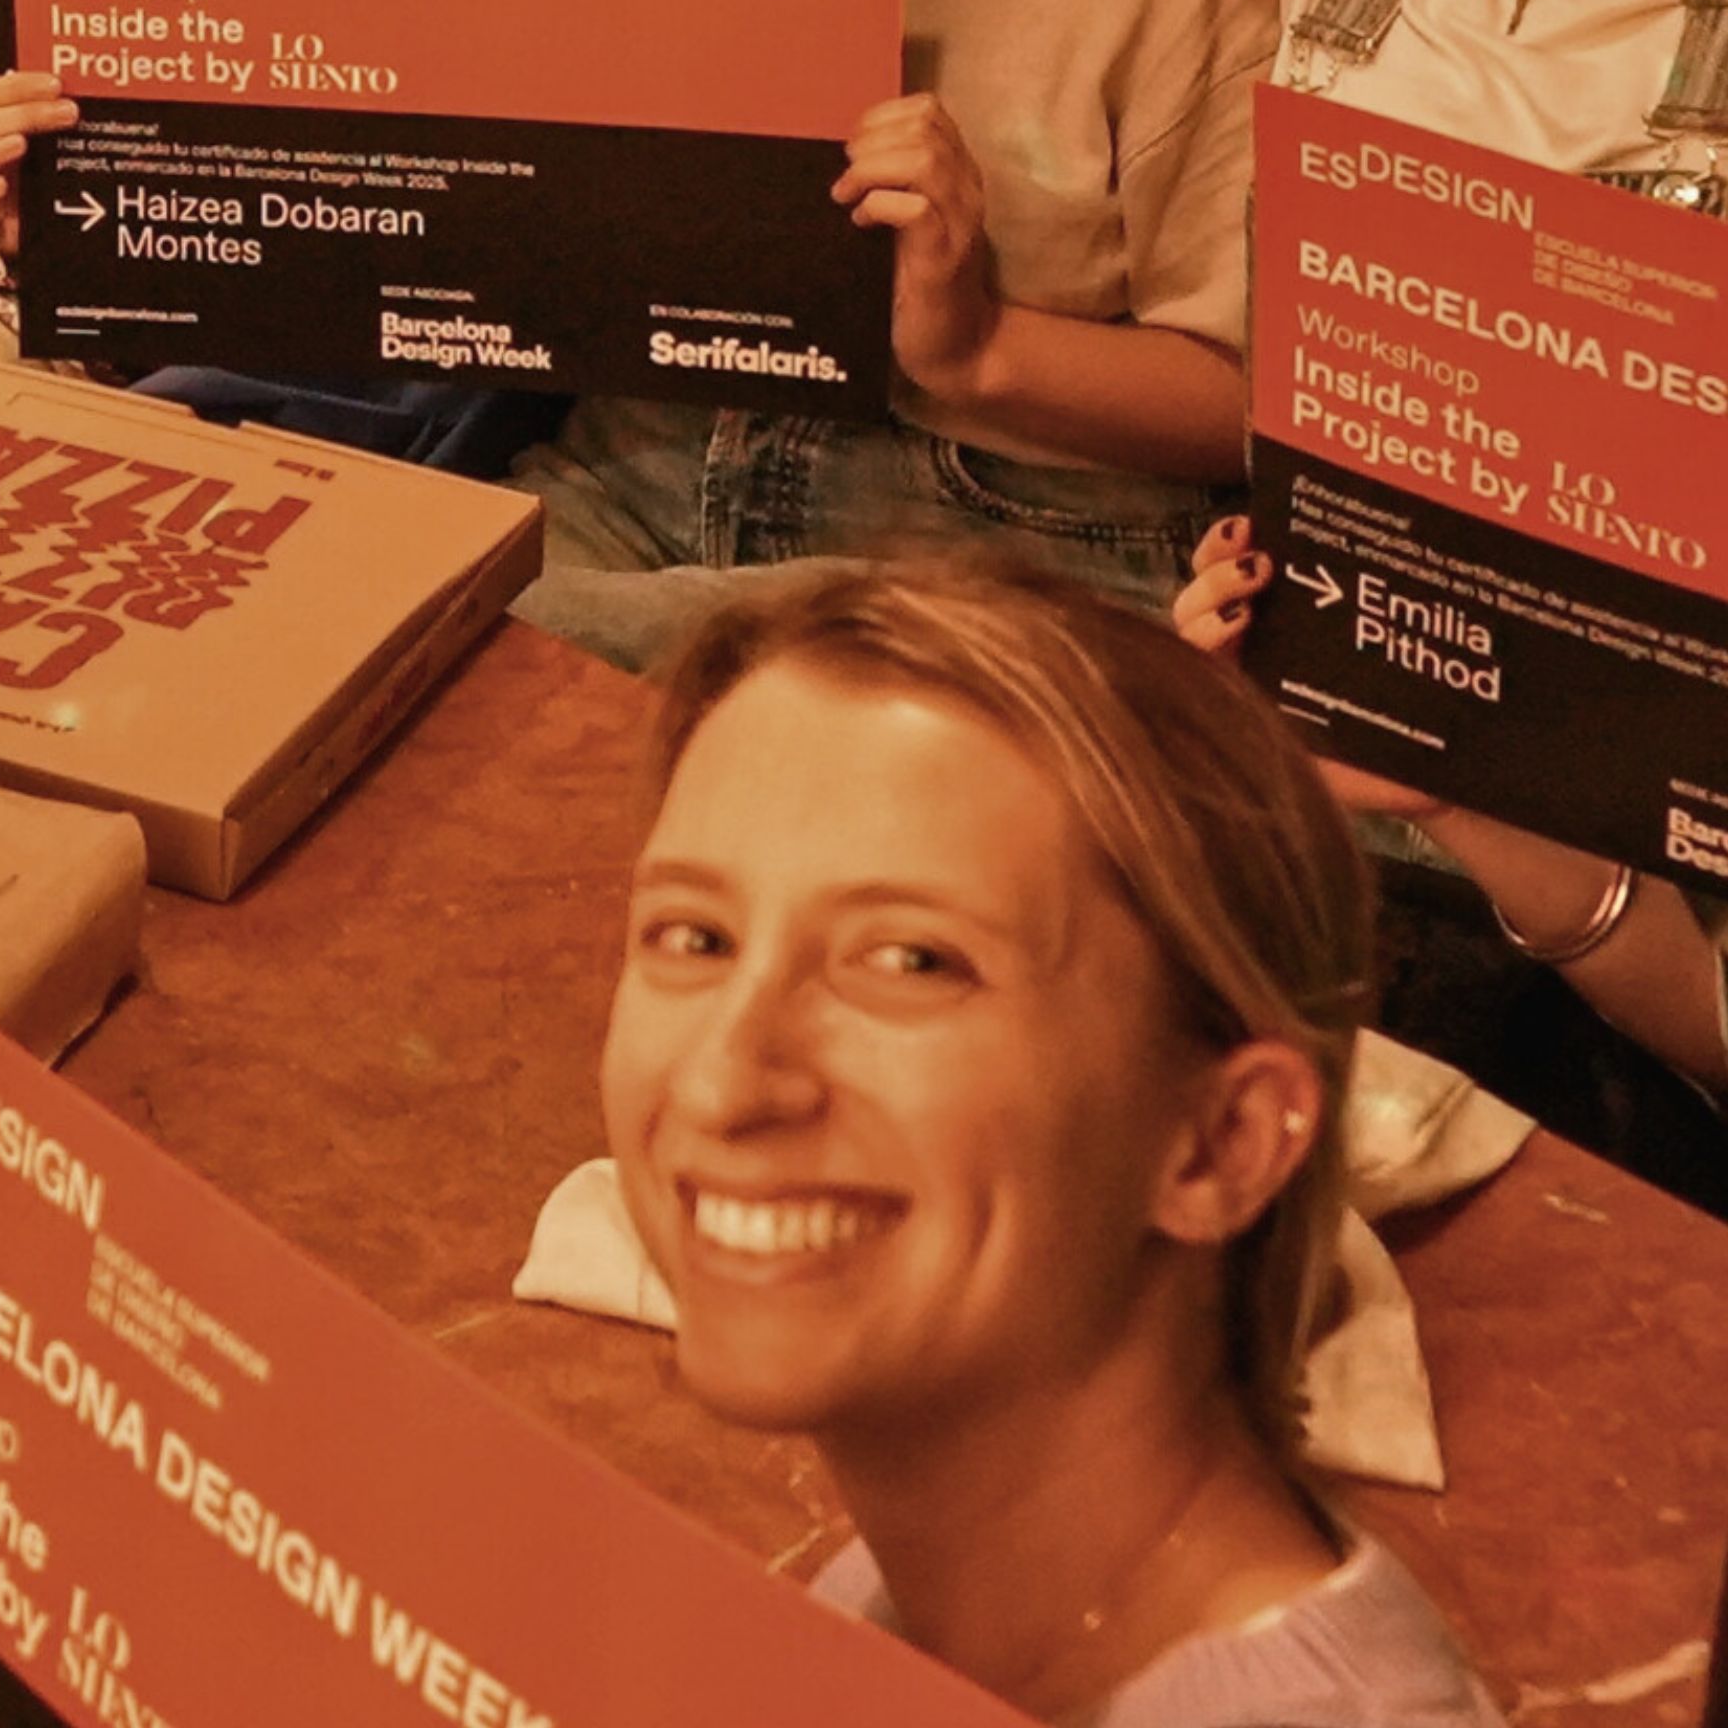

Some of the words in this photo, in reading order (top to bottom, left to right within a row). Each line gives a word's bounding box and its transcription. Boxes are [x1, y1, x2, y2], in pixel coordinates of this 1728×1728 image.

[117, 185, 243, 226] Haizea
[260, 192, 425, 236] Dobaran
[1300, 142, 1534, 231] ESDESIGN
[117, 223, 262, 266] Montes
[1299, 240, 1609, 378] BARCELONA
[649, 330, 847, 382] Serifalaris.
[1357, 572, 1492, 656] Emilia
[1355, 614, 1501, 702] Pithod
[157, 1431, 359, 1635] DESIGN
